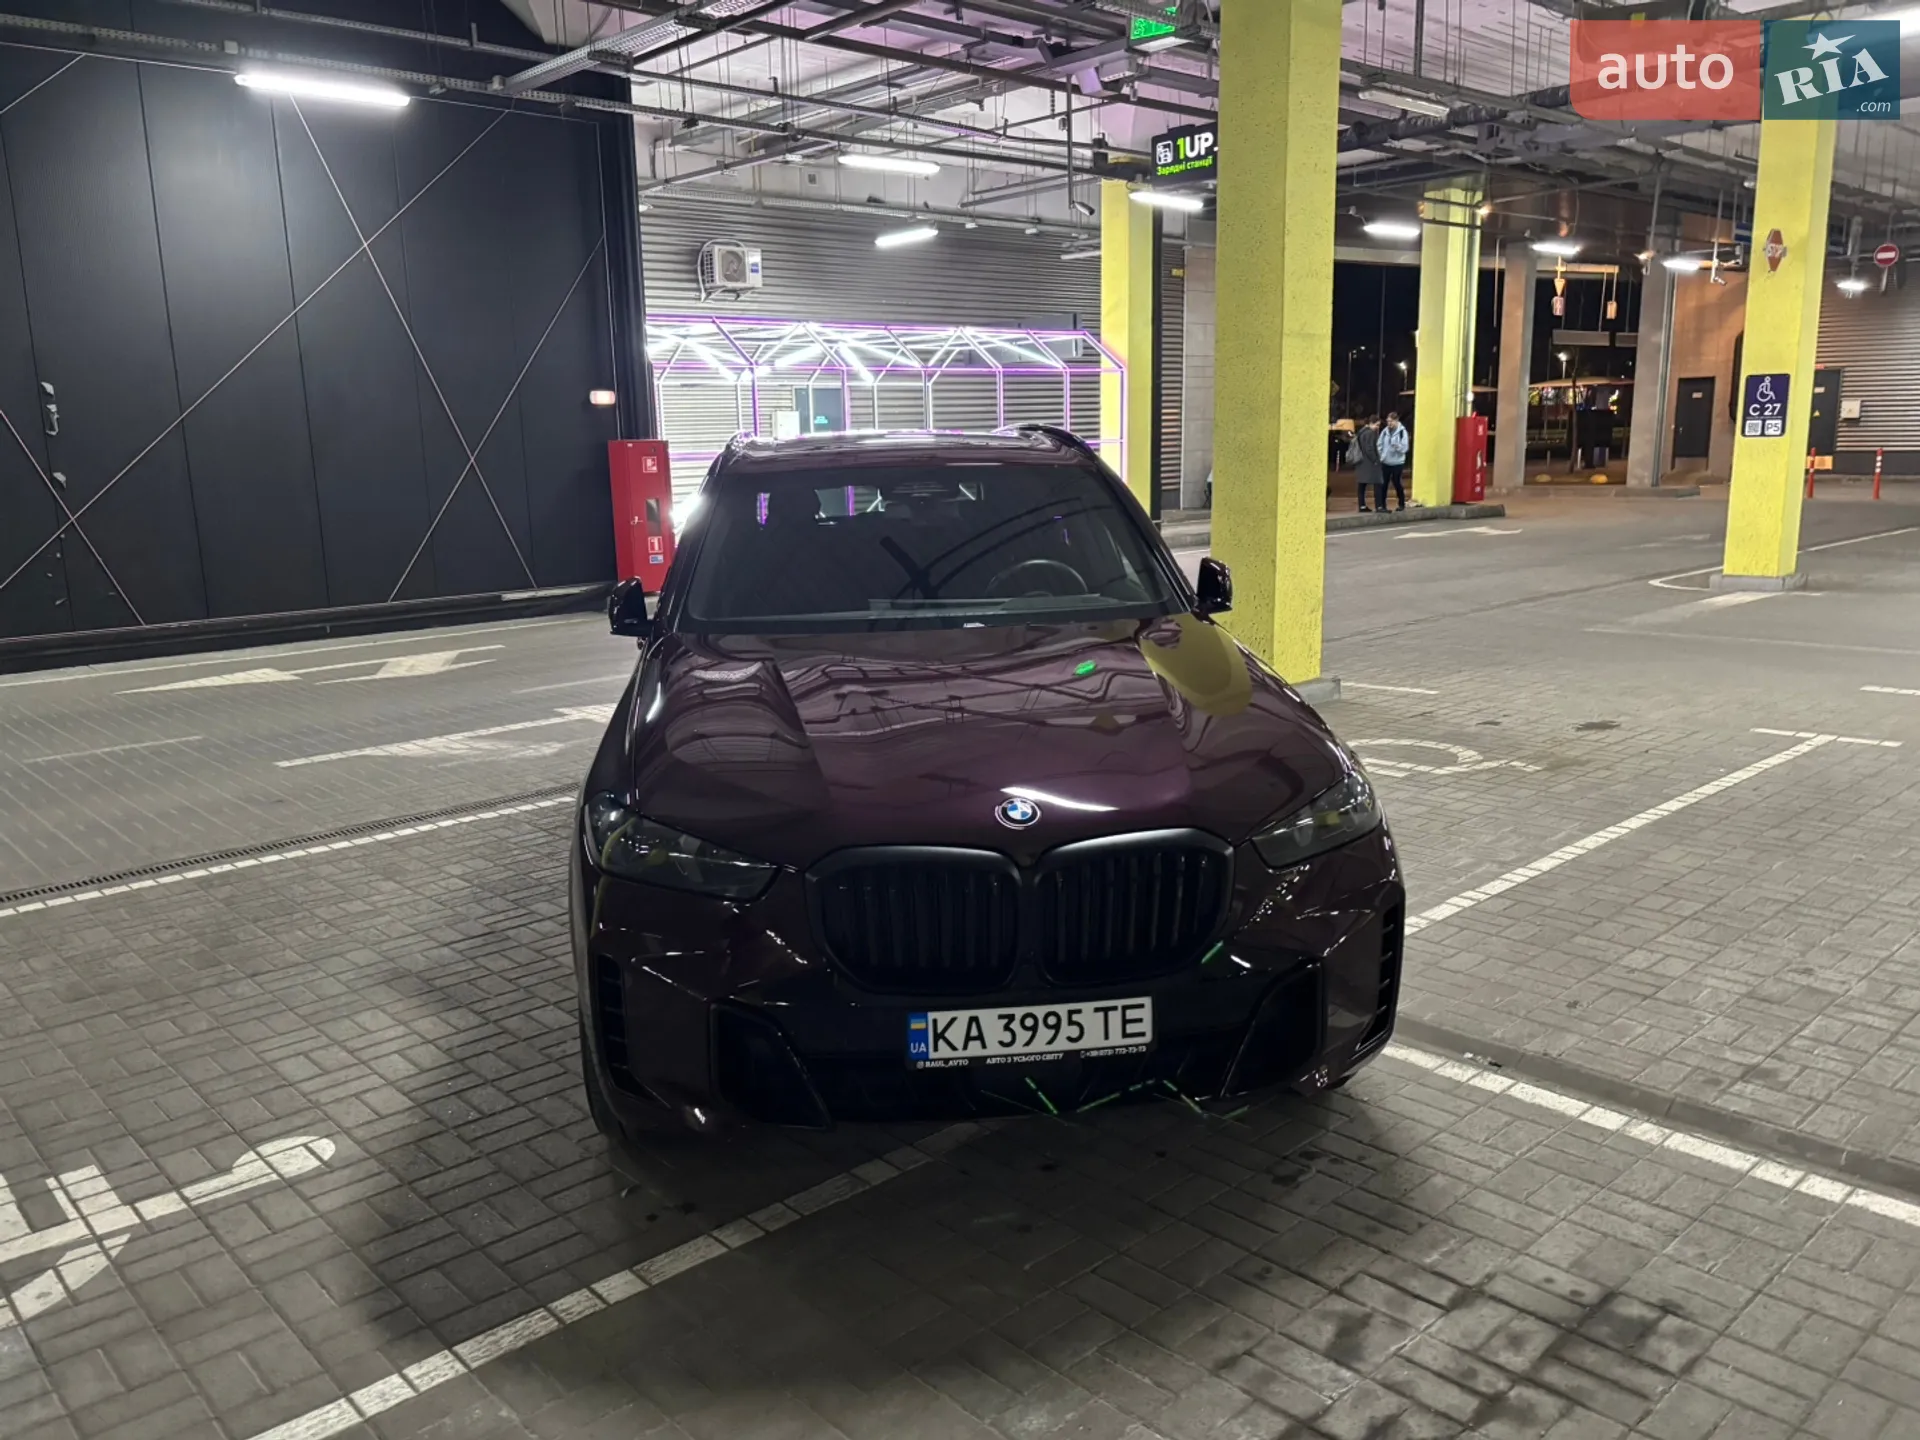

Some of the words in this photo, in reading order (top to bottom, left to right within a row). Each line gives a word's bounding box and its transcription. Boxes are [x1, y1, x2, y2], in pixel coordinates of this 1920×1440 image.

[1763, 403, 1781, 416] 27
[1766, 423, 1780, 432] P5
[932, 1015, 987, 1052] KA
[997, 1010, 1085, 1047] 3995
[1094, 1003, 1146, 1040] TE
[910, 1042, 927, 1053] UA
